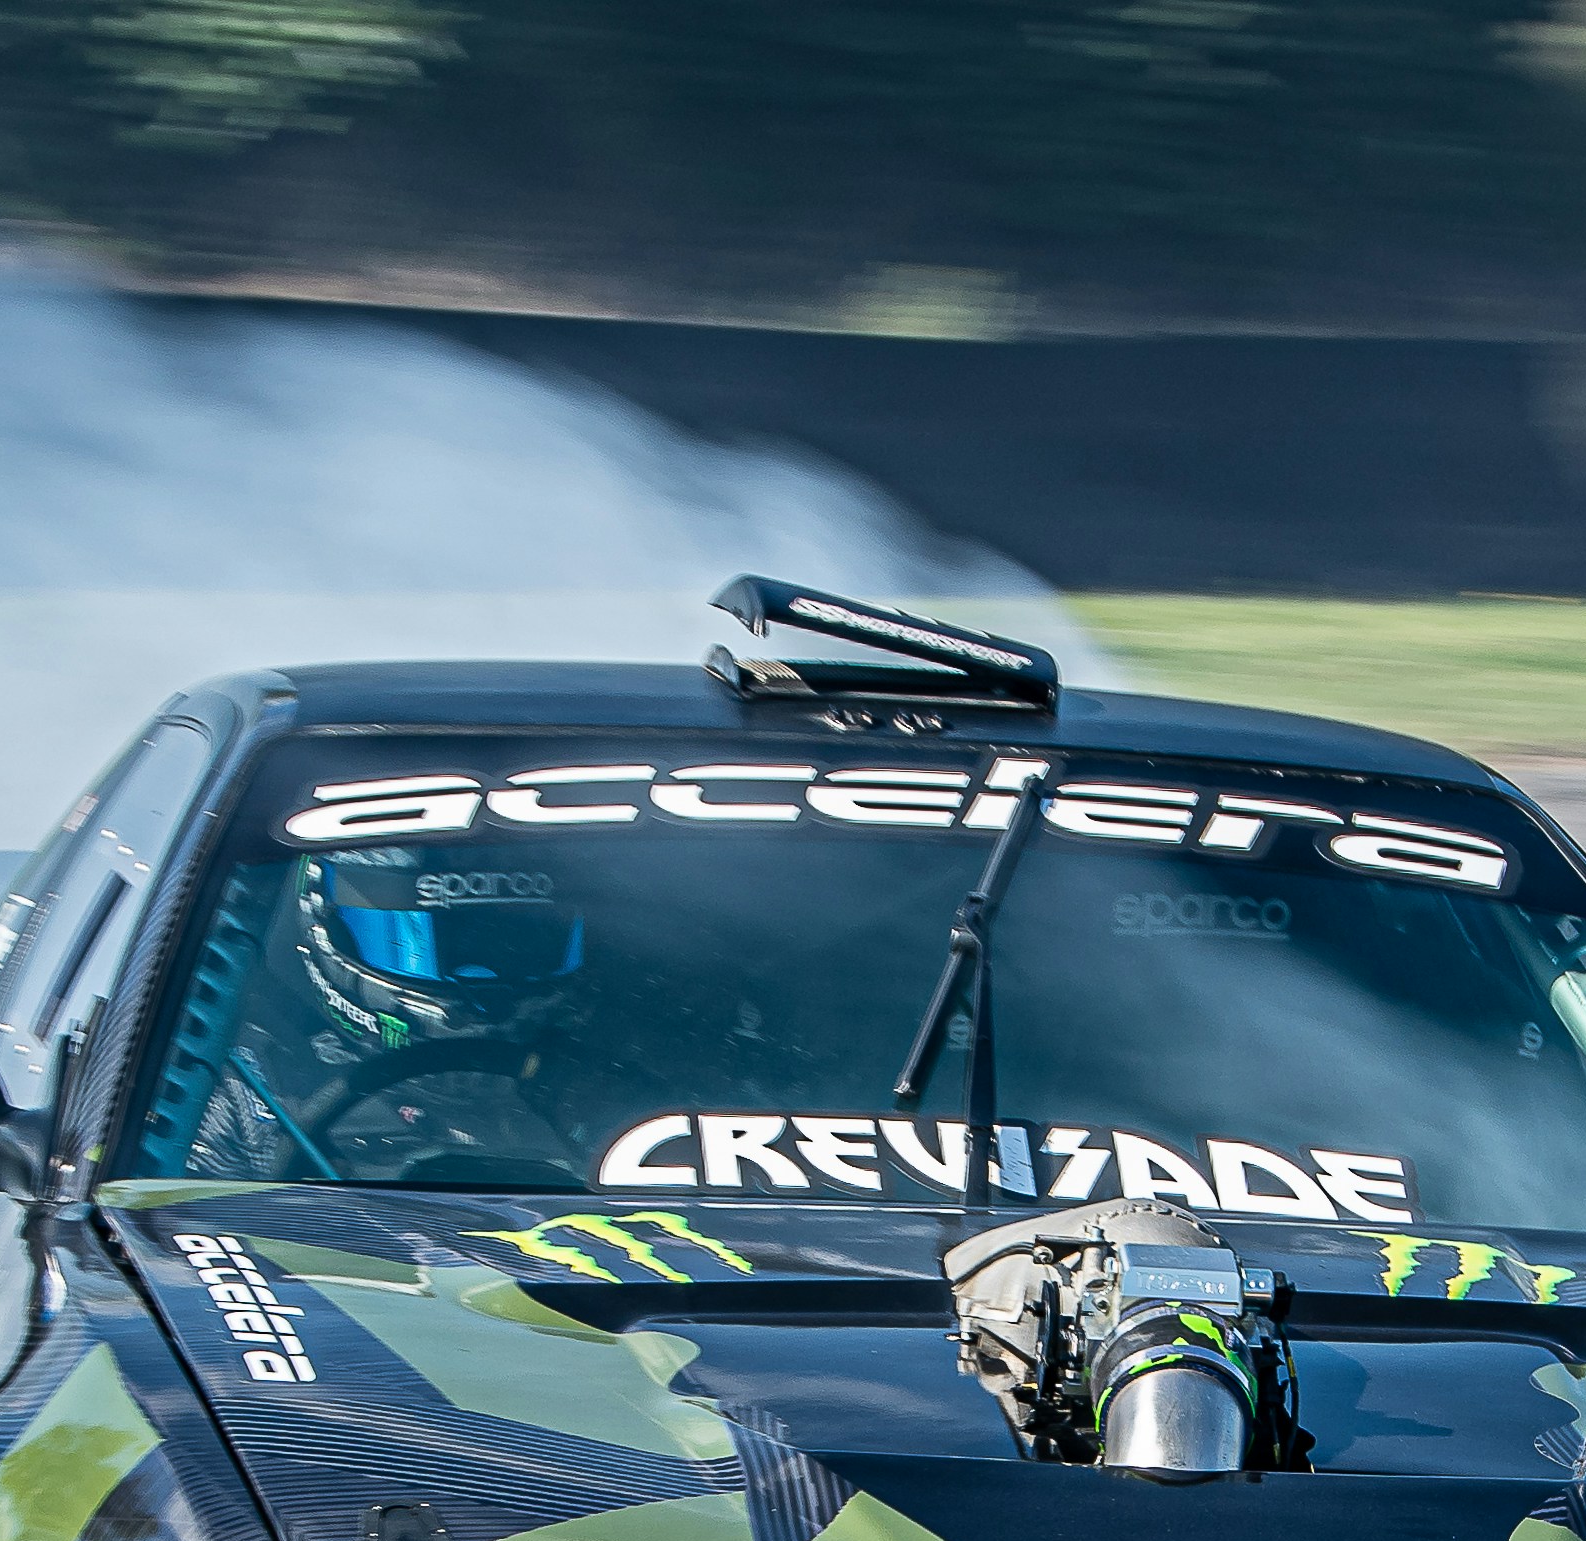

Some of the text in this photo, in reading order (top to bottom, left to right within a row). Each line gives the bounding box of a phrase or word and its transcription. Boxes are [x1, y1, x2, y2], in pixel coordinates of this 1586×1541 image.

[283, 757, 1508, 891] accelera
[415, 872, 554, 909] sparco
[1113, 894, 1292, 937] sparco
[172, 1233, 317, 1382] accelera
